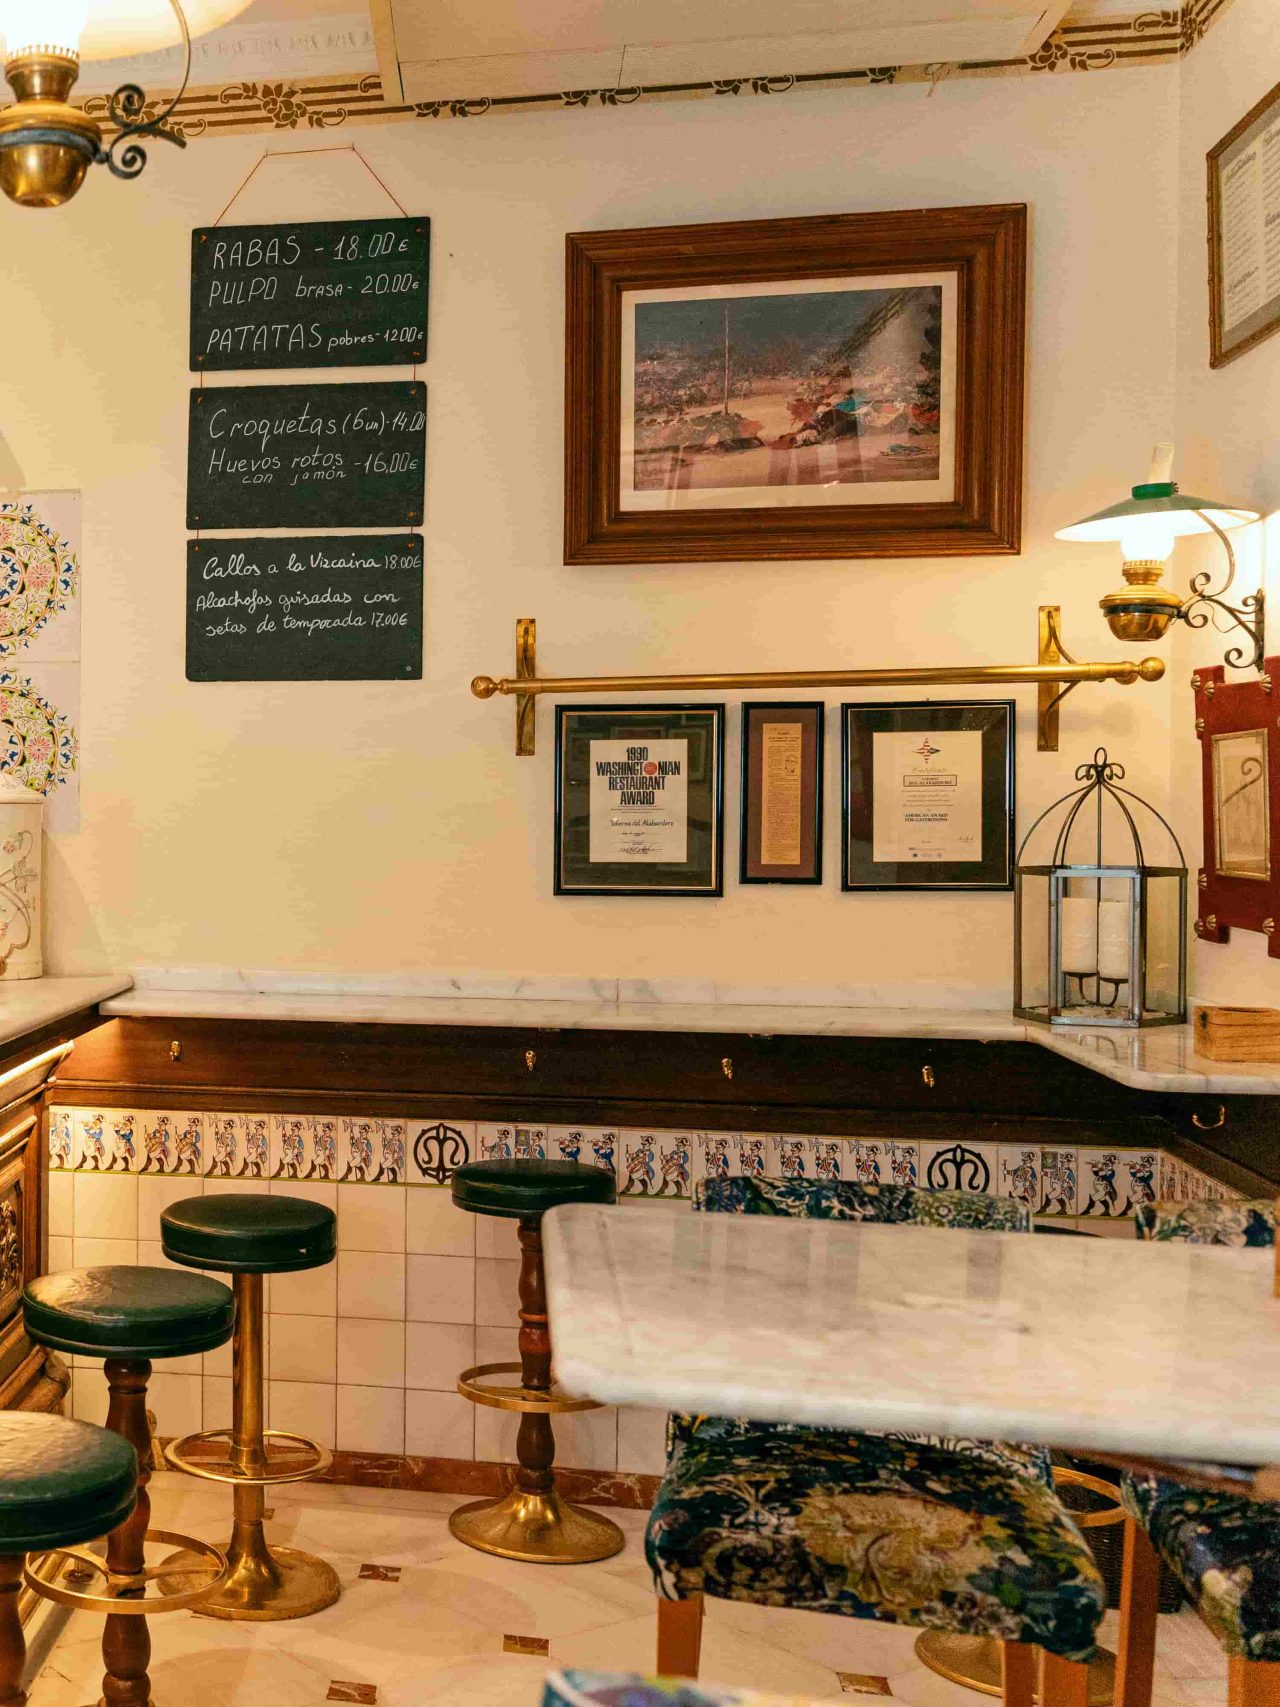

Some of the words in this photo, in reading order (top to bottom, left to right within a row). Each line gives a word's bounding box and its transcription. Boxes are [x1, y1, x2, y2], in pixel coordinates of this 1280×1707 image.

[213, 236, 301, 270] RABAS
[333, 232, 409, 261] 18.00€
[209, 276, 278, 307] PULPO
[361, 273, 420, 295] 20.00€
[206, 323, 322, 354] PATATAS
[328, 329, 375, 352] pobres
[210, 402, 337, 453] Croquetas
[208, 447, 281, 474] Huevos
[291, 445, 344, 470] rotos
[242, 473, 273, 484] con
[290, 465, 347, 486] jamón
[203, 553, 261, 580] Callos
[267, 564, 279, 574] a
[286, 553, 306, 572] la
[196, 589, 272, 614] Alcachofas
[278, 587, 352, 612] guisadas
[363, 592, 400, 603] con
[205, 617, 247, 637] setas
[256, 614, 276, 634] de
[282, 610, 367, 637] temporada
[625, 746, 649, 761] 1990
[608, 776, 666, 790] RESTAURANT
[620, 791, 655, 805] AWARD
